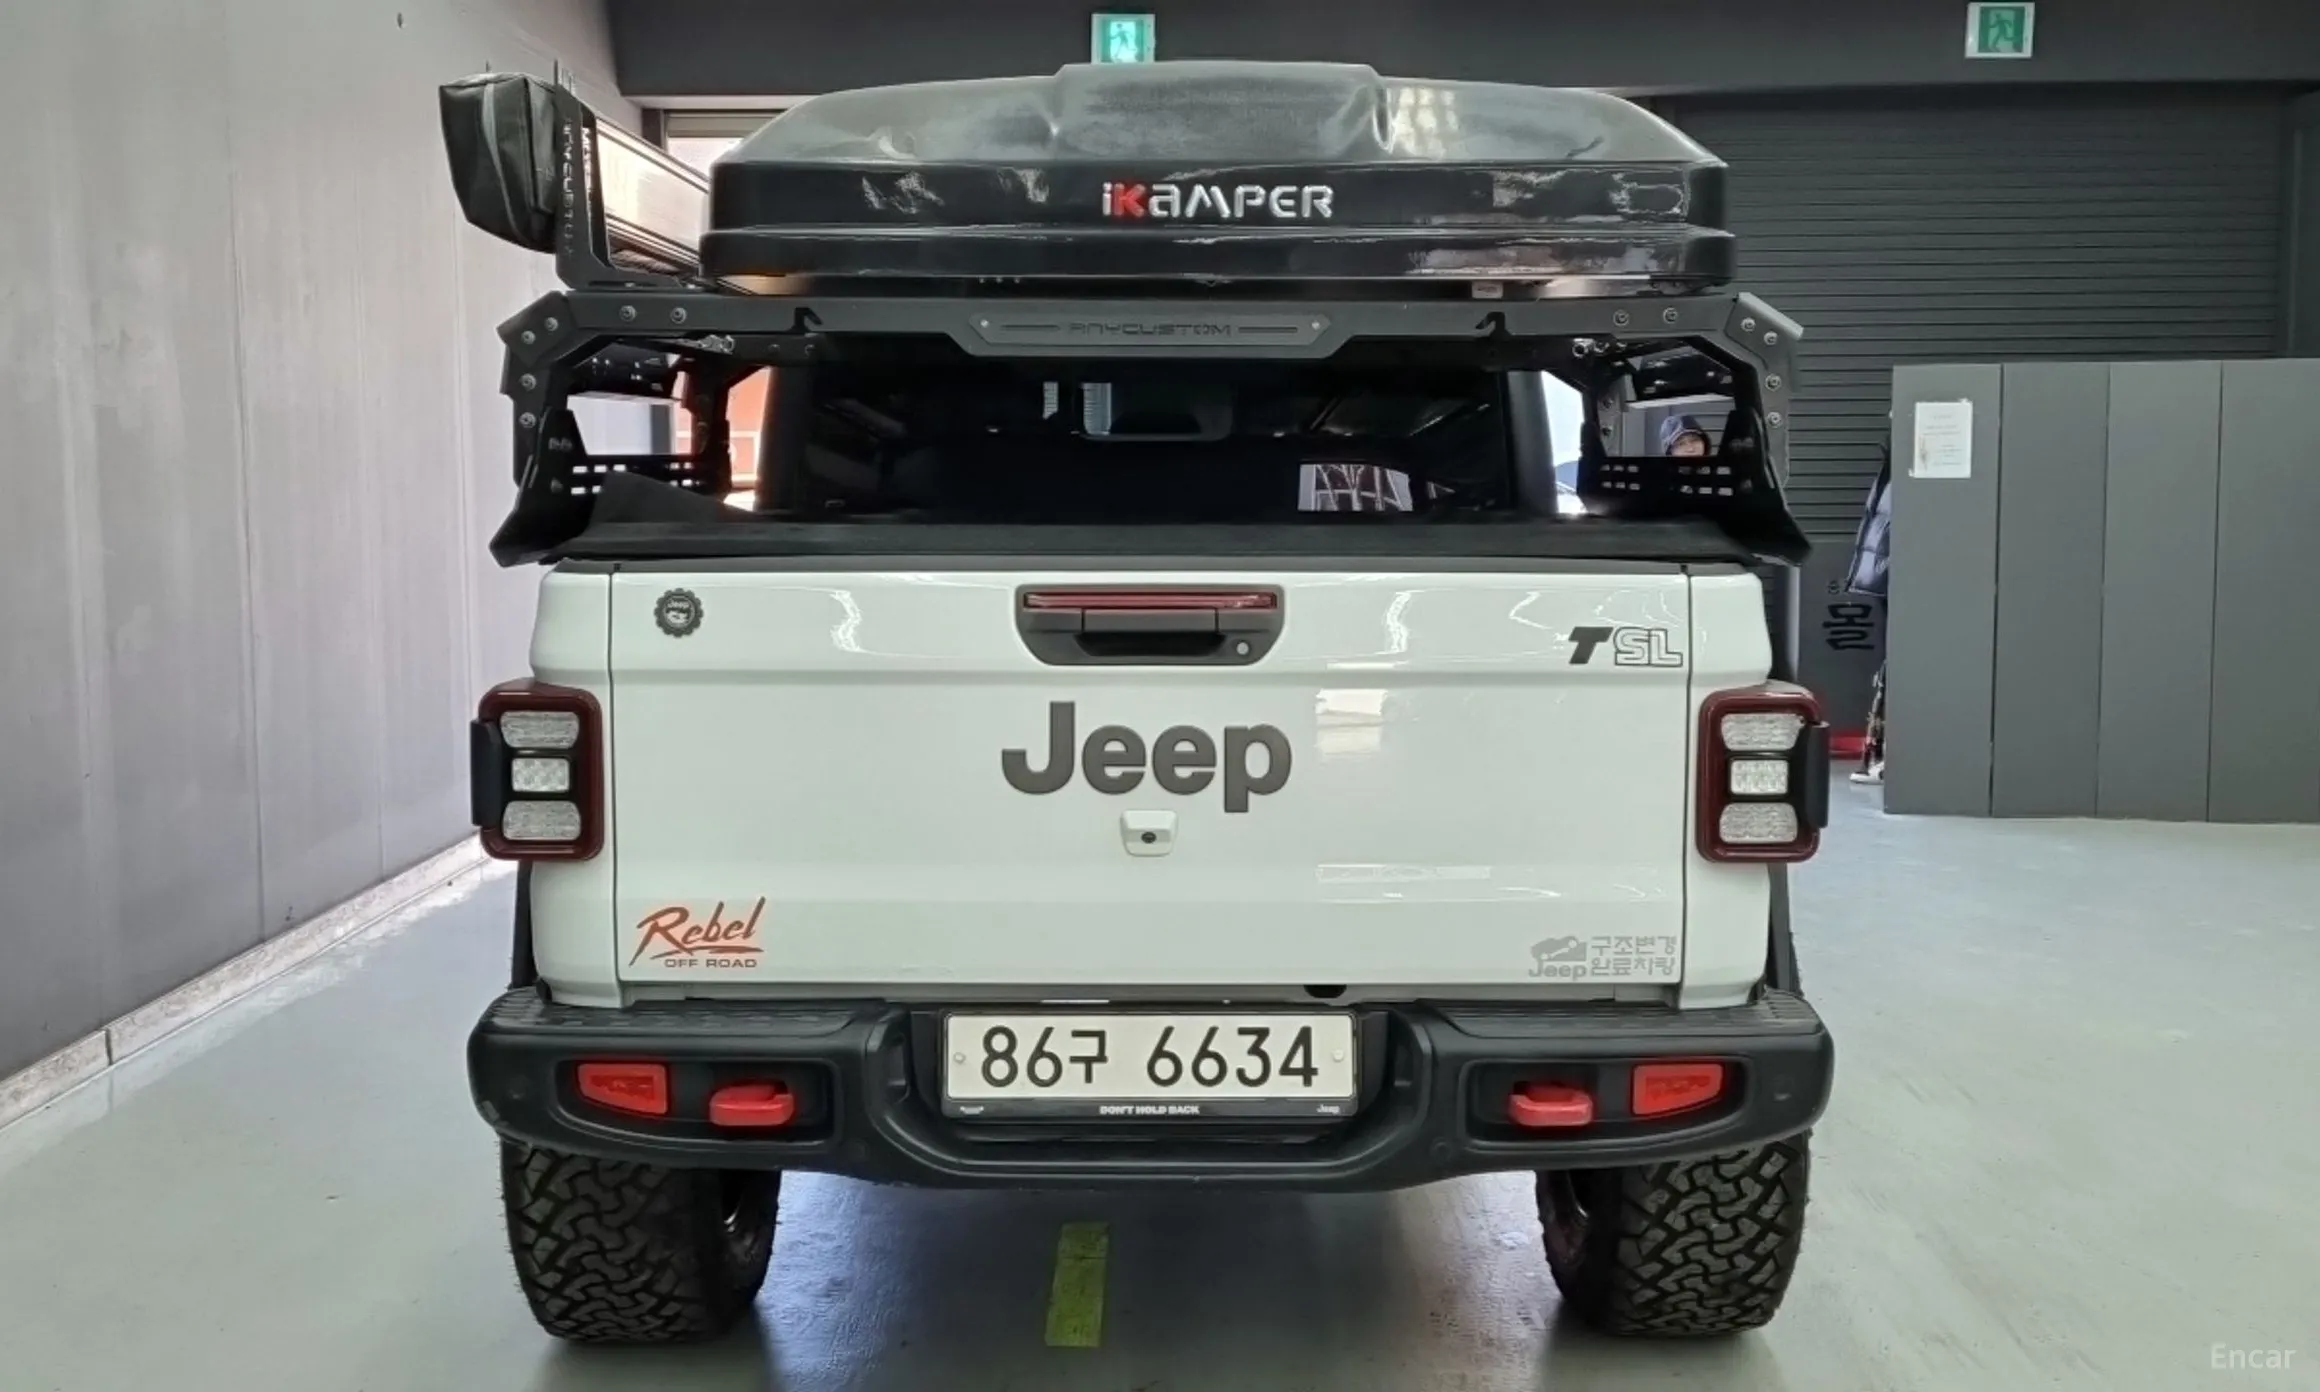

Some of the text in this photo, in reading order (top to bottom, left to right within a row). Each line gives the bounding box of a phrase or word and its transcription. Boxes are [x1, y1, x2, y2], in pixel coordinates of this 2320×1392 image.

[1068, 322, 1232, 336] ANYCUSTOM
[1568, 626, 1684, 668] TSL
[1001, 701, 1293, 813] Jeep
[629, 896, 767, 967] Rebel
[1591, 935, 1678, 957] 구조변경
[664, 958, 757, 968] OFF ROAD
[1528, 959, 1587, 981] Jeep
[1591, 957, 1677, 977] 완료차량
[981, 1025, 1319, 1088] 86구 6634
[1135, 1105, 1168, 1115] HOLD
[1168, 1105, 1200, 1115] BACK
